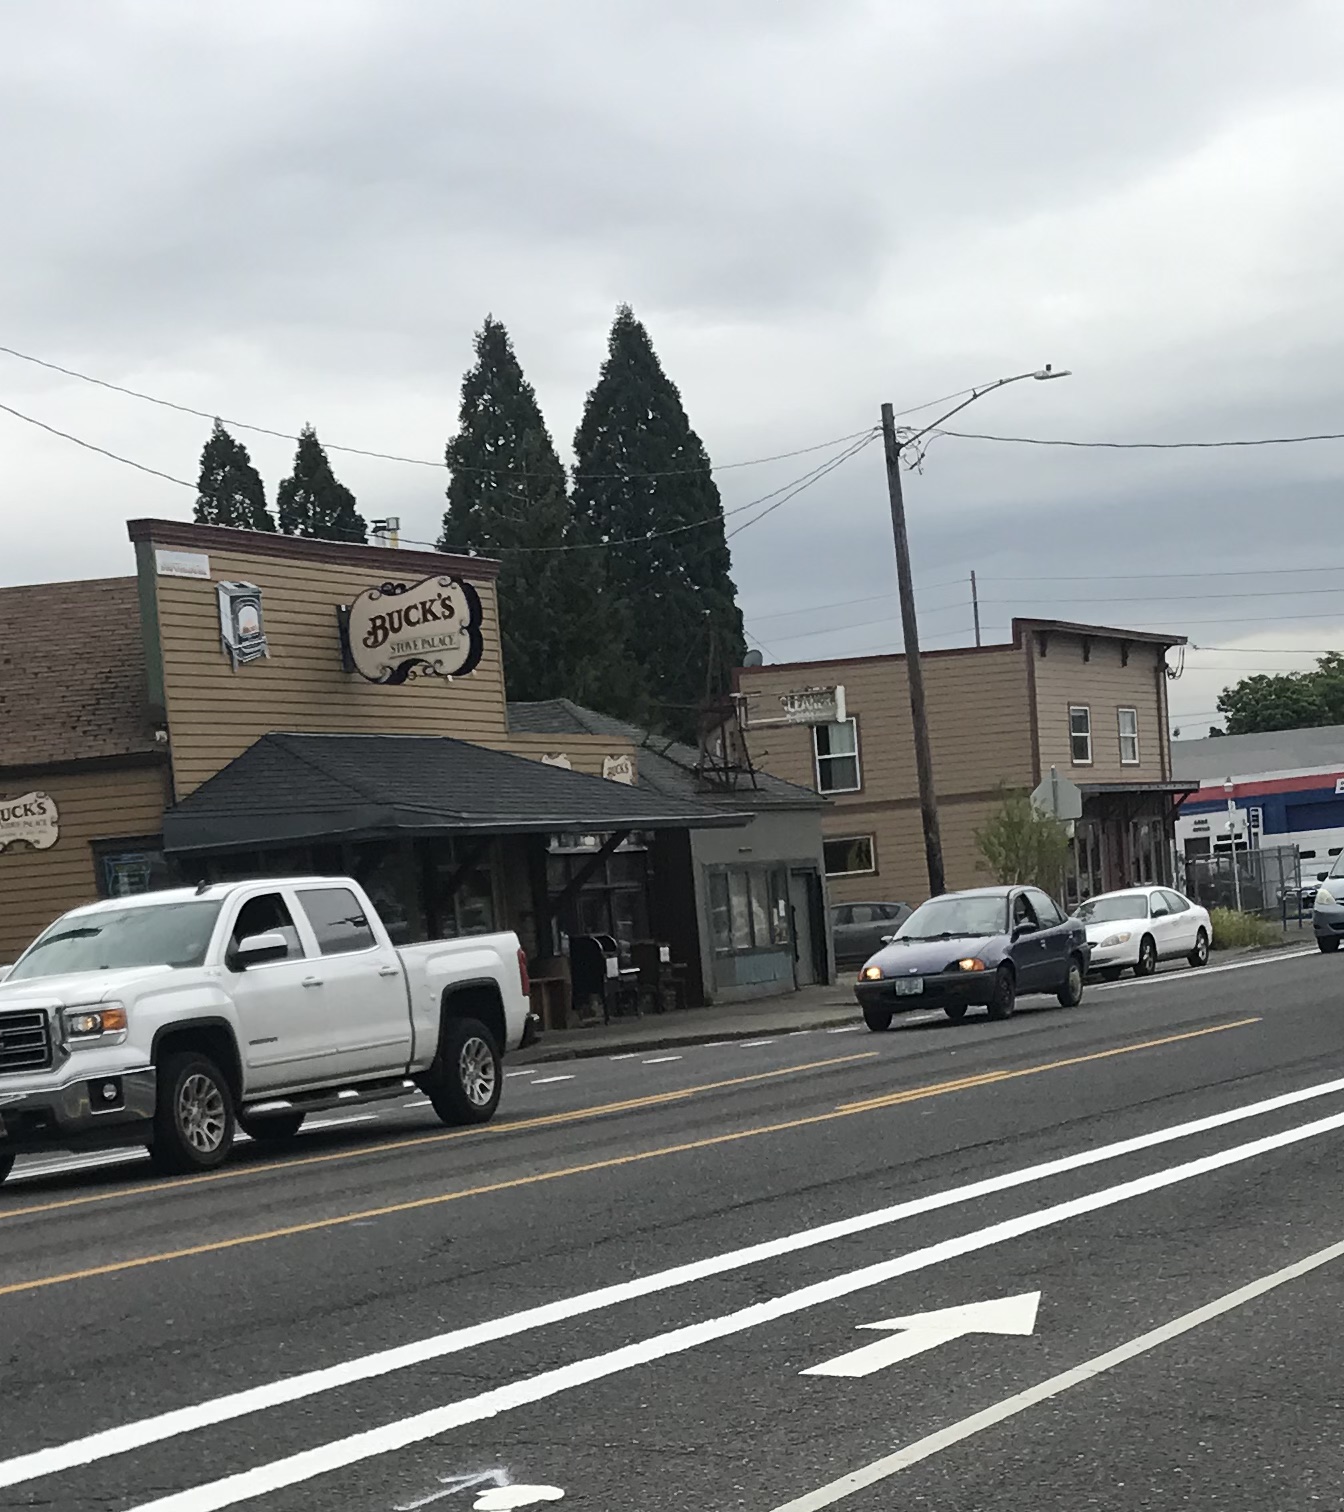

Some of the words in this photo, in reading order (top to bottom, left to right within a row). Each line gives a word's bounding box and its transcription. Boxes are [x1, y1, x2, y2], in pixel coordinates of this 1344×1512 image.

[362, 592, 455, 648] BUCK'S
[390, 641, 417, 655] STOVE
[420, 634, 456, 649] PALACE
